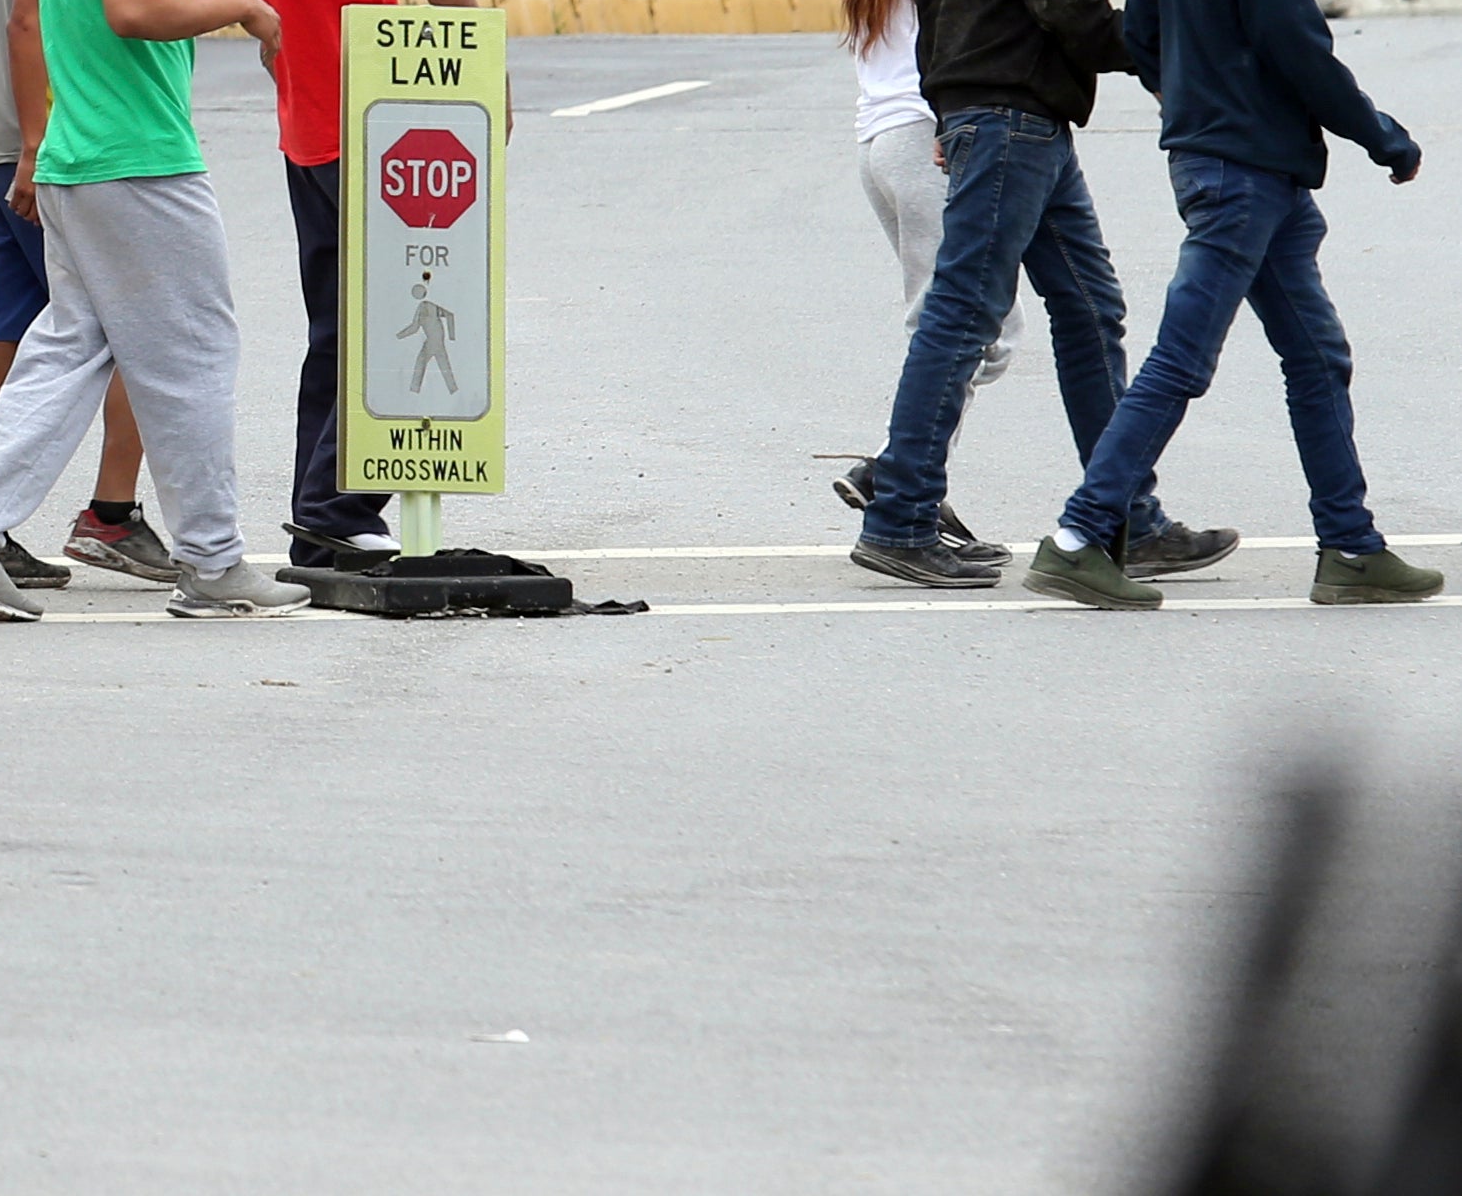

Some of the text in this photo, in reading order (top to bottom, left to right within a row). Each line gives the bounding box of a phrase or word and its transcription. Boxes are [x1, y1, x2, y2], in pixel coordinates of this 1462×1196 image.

[377, 19, 478, 50] STATE
[391, 58, 462, 85] LAW
[385, 159, 472, 197] STOP
[405, 244, 449, 268] FOR
[389, 428, 462, 451] WITHIN
[363, 459, 488, 482] CROSSWALK
